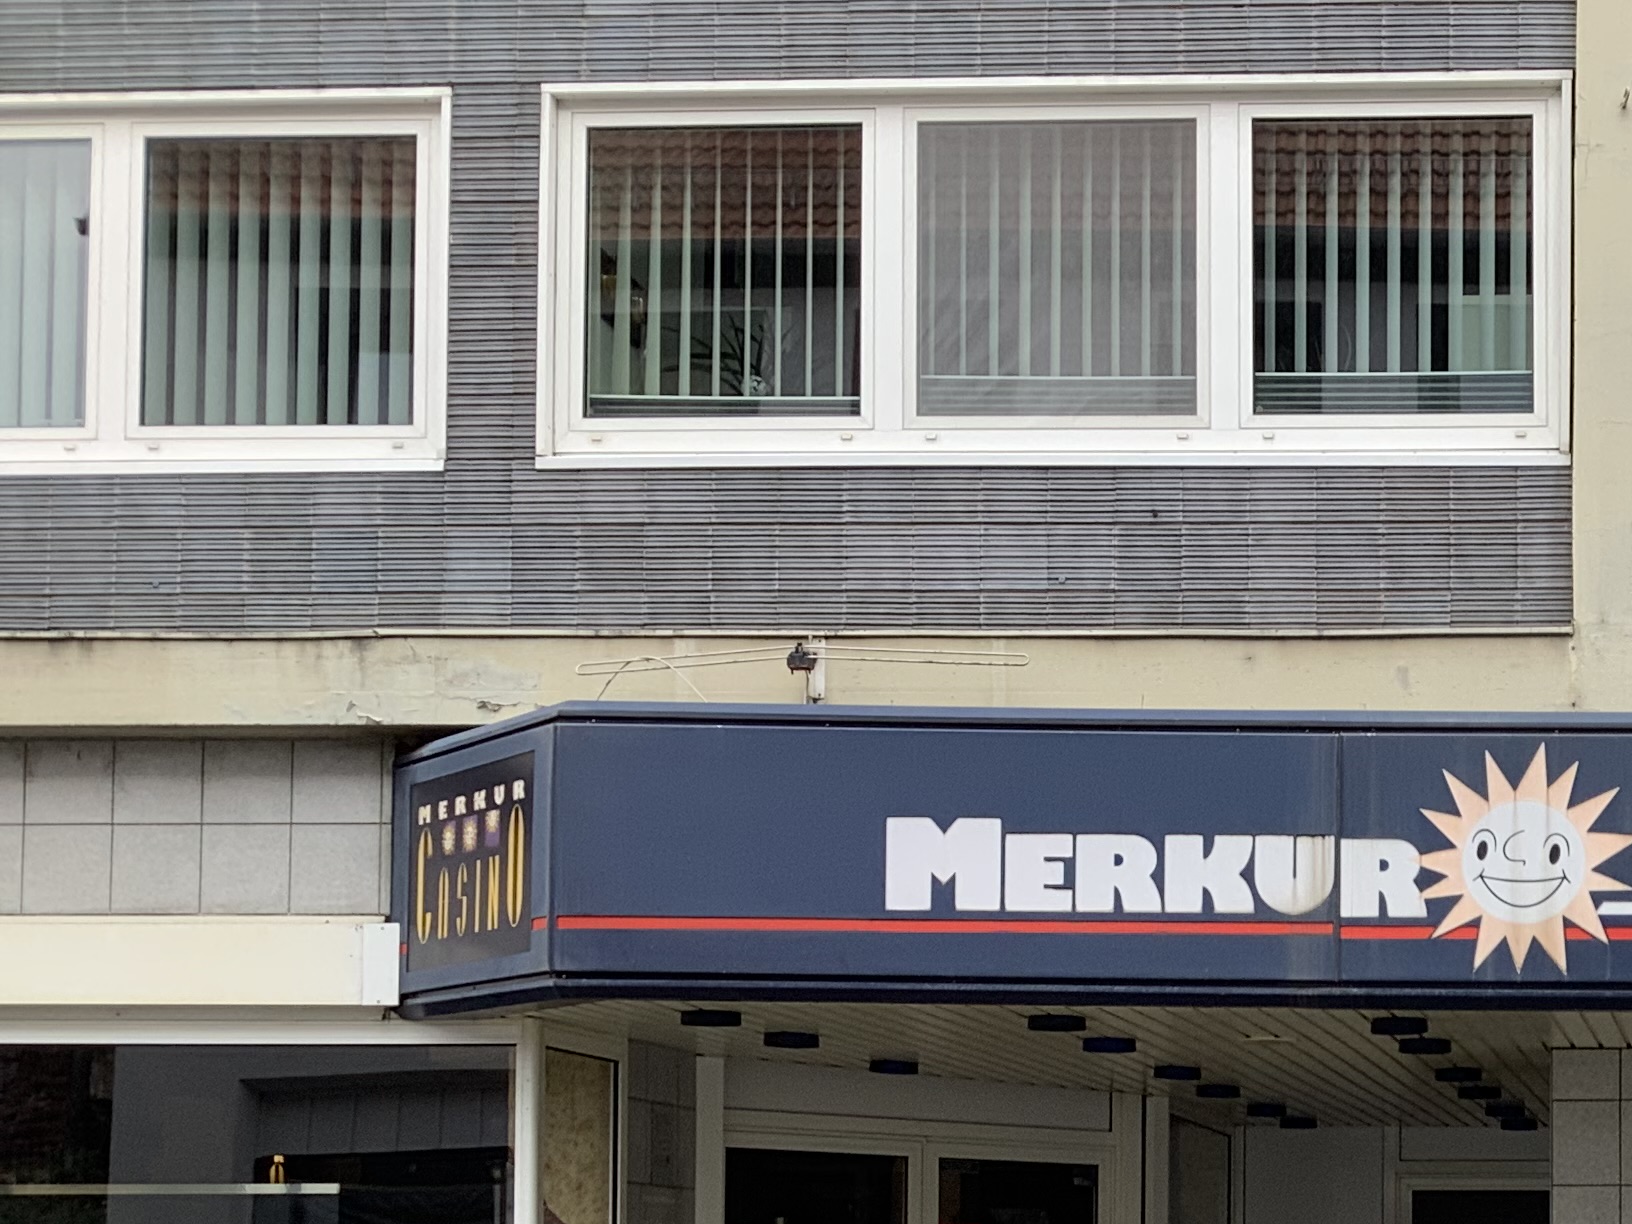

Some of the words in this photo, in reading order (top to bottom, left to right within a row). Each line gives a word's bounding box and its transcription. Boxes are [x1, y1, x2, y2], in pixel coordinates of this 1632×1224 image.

[417, 779, 526, 825] MERKUR
[416, 803, 525, 944] CASINO
[886, 816, 1428, 918] MERKUR
